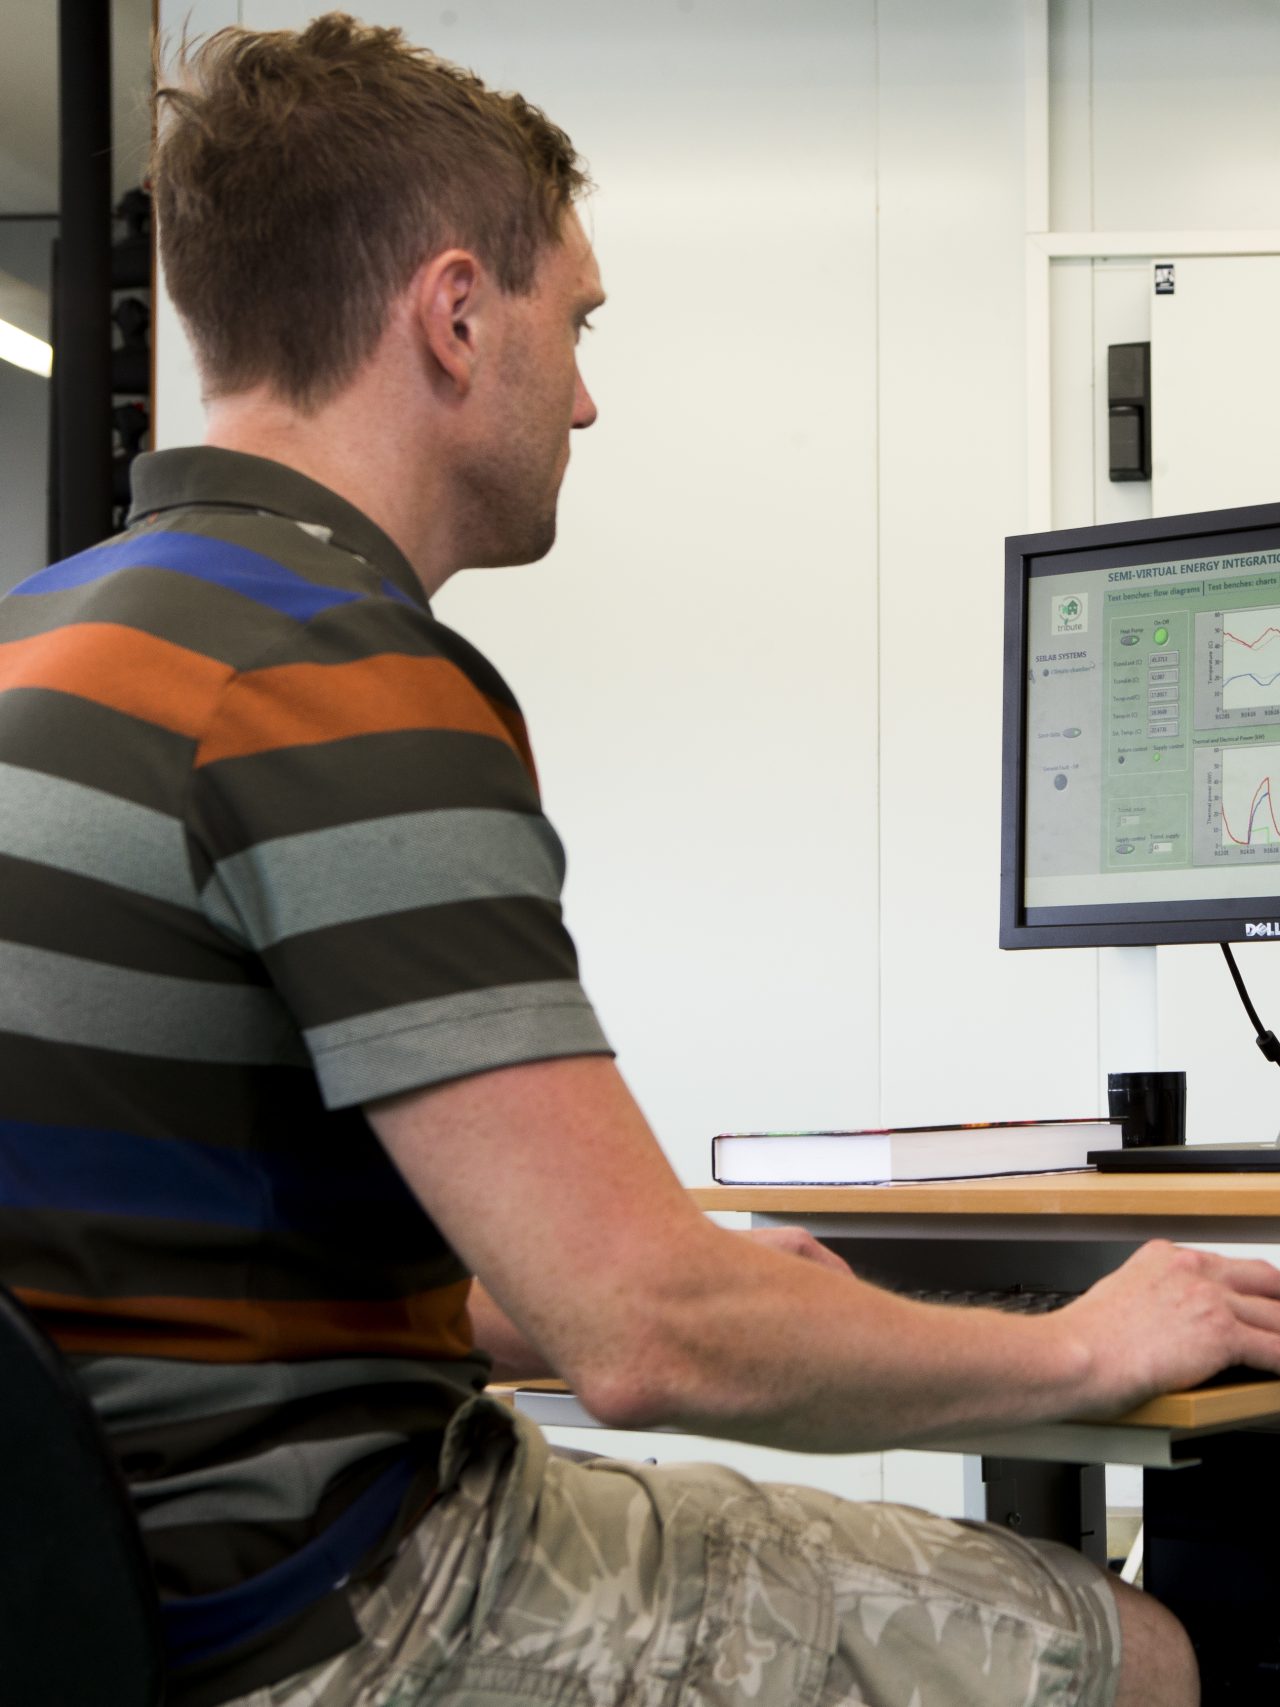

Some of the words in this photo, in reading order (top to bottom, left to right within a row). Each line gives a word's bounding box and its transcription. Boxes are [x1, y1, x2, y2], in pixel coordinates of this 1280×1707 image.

[1108, 565, 1178, 582] SEMI-VIRTUAL
[1180, 560, 1220, 575] ENERGY
[1208, 582, 1222, 592] Test
[1224, 579, 1254, 591] benches:
[1256, 577, 1277, 587] charts
[1108, 593, 1122, 602] Test
[1124, 590, 1152, 601] benches:
[1154, 588, 1168, 598] flow
[1170, 586, 1200, 598] diagrams
[1058, 624, 1082, 632] tribute
[1036, 653, 1056, 662] SEILAB
[1058, 651, 1087, 660] SYSTEMS
